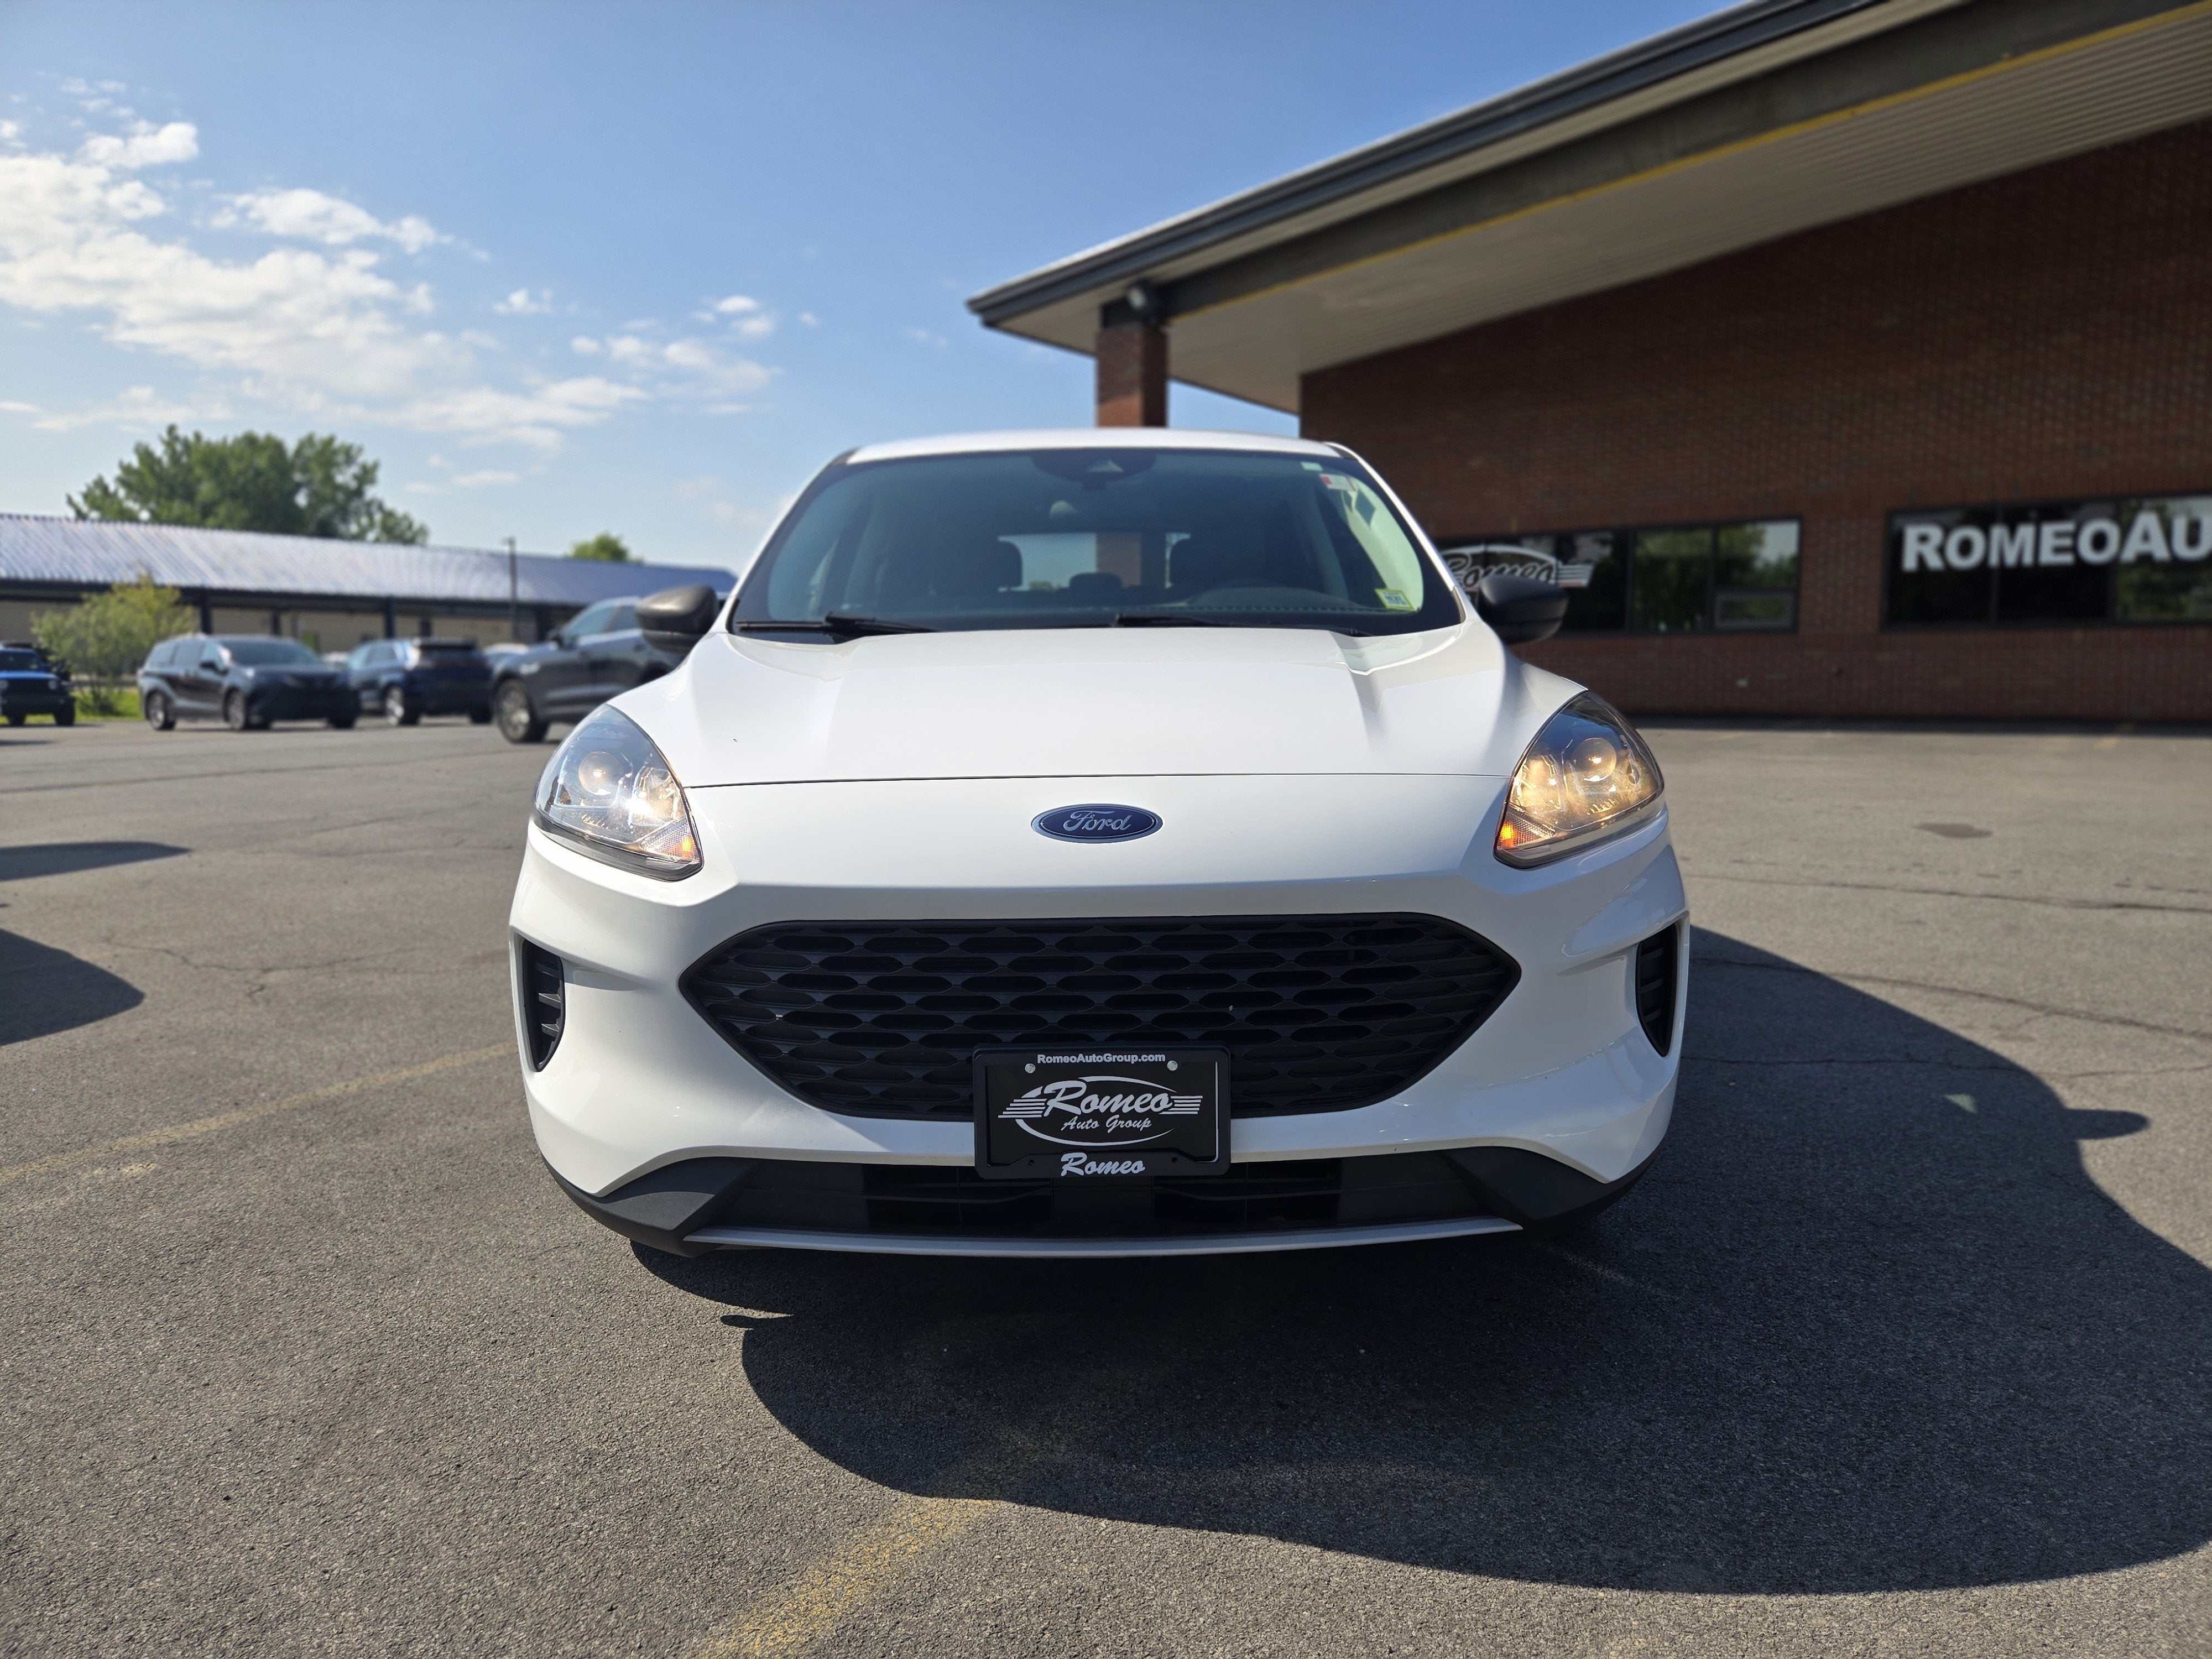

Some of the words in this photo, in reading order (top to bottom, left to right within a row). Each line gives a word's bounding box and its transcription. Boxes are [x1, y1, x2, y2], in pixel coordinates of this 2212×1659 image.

[1063, 810, 1132, 831] Ford
[1037, 1053, 1166, 1064] RomeoAutoGroup.com
[1043, 1080, 1172, 1117] Romeo
[1061, 1115, 1100, 1131] Auto
[1105, 1114, 1152, 1134] Group
[1060, 1152, 1146, 1177] Romeo
